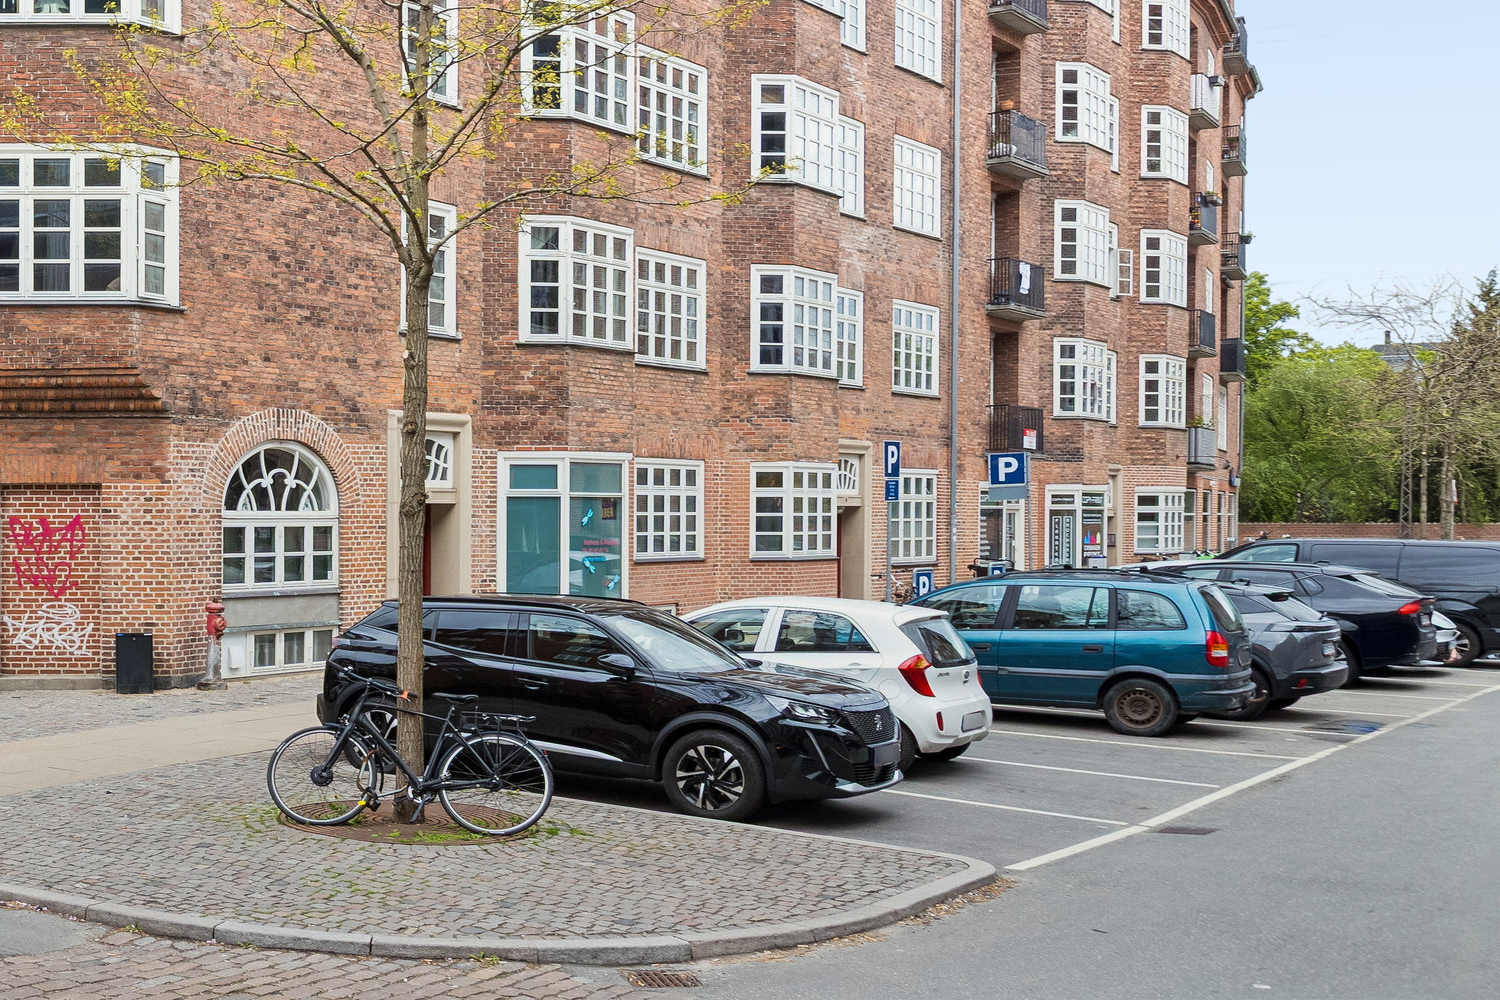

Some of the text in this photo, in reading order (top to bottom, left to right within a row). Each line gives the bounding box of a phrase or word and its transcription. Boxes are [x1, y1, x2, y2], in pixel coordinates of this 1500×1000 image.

[887, 445, 898, 474] P
[998, 456, 1019, 482] P
[918, 575, 930, 597] P
